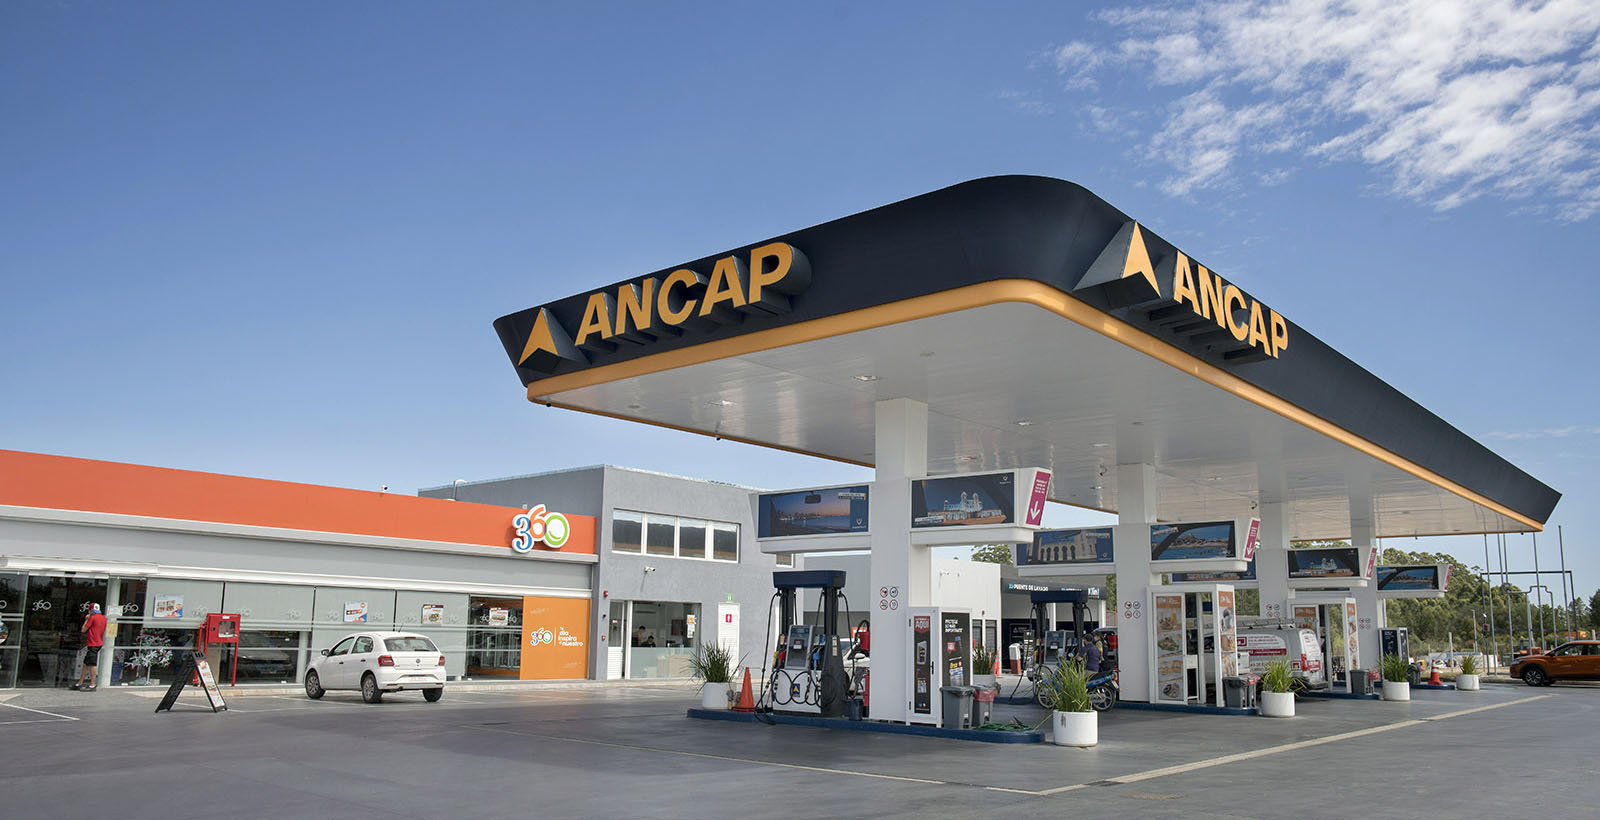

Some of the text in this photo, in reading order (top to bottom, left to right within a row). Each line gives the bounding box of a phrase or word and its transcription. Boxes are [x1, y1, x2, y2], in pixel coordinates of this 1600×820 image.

[574, 241, 793, 347] ANCAP
[1173, 250, 1289, 359] ANCAP
[512, 503, 570, 553] 360
[32, 600, 51, 611] 360
[79, 601, 90, 612] 36
[530, 627, 553, 646] 360
